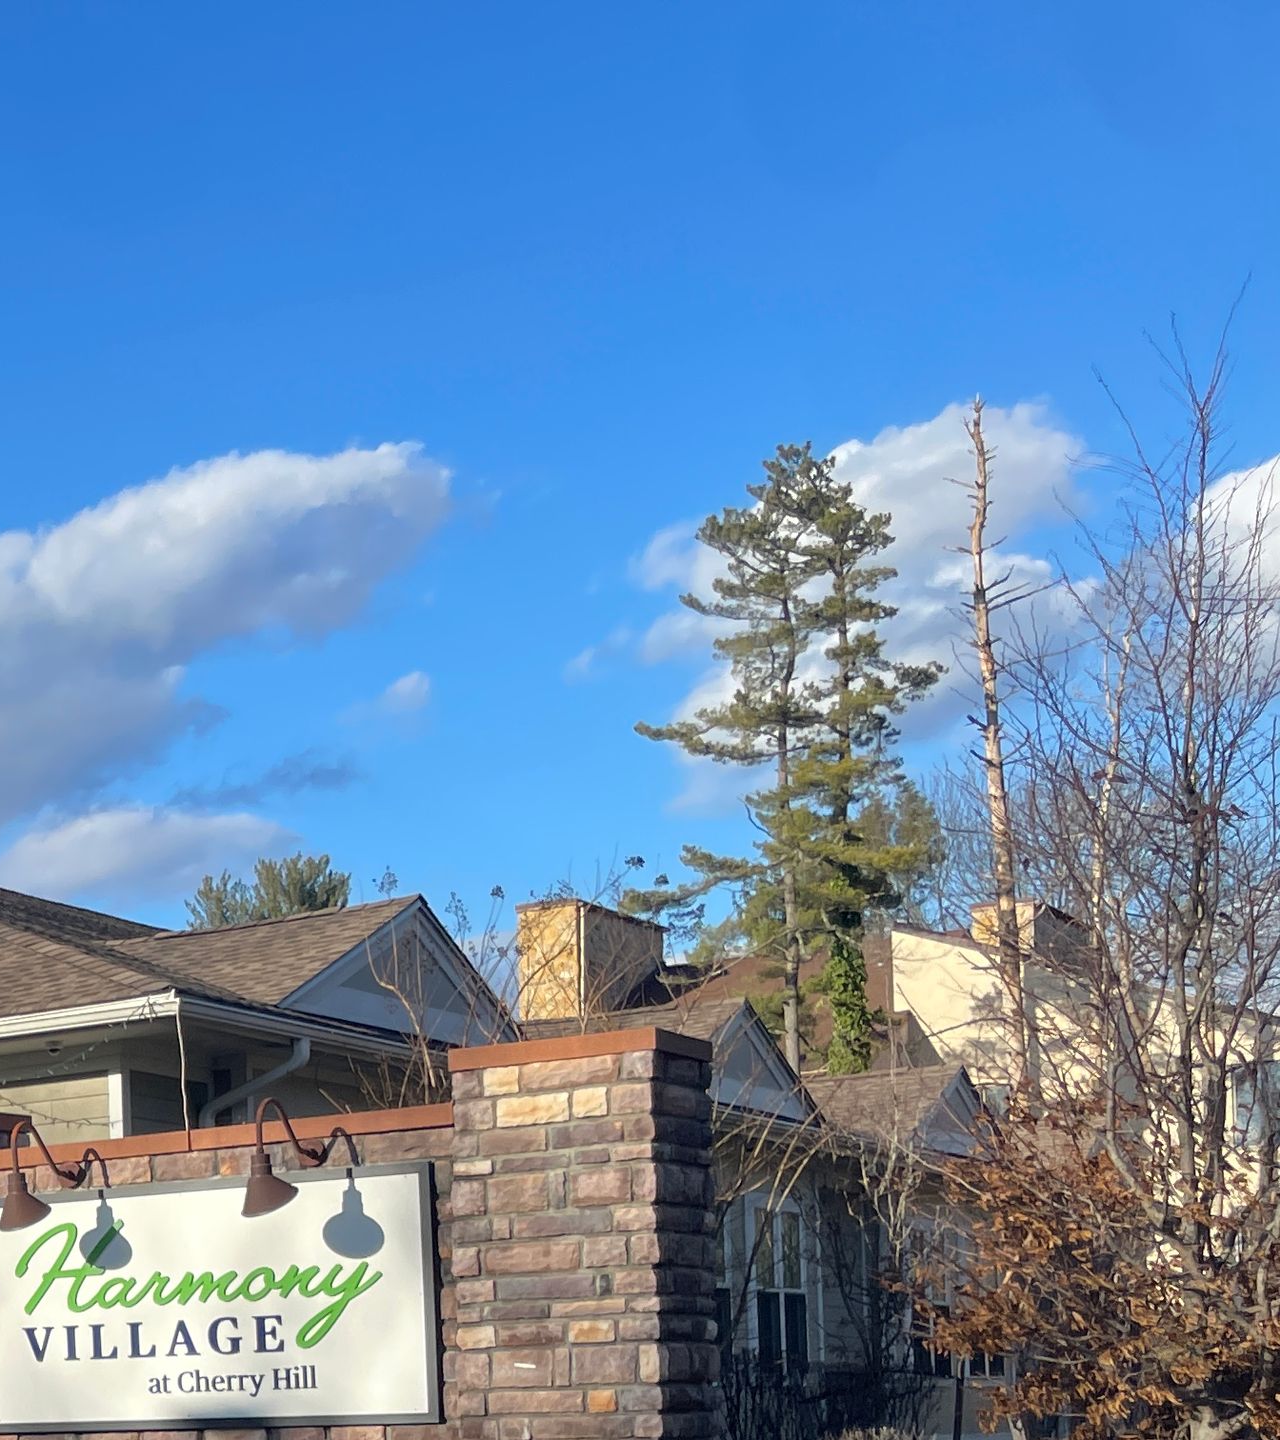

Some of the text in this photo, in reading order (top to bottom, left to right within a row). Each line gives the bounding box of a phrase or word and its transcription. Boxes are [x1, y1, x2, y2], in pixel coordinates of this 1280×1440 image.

[15, 1219, 383, 1349] Harmony
[22, 1314, 286, 1362] VILLAGE
[148, 1365, 318, 1397] at Cherry Hill
